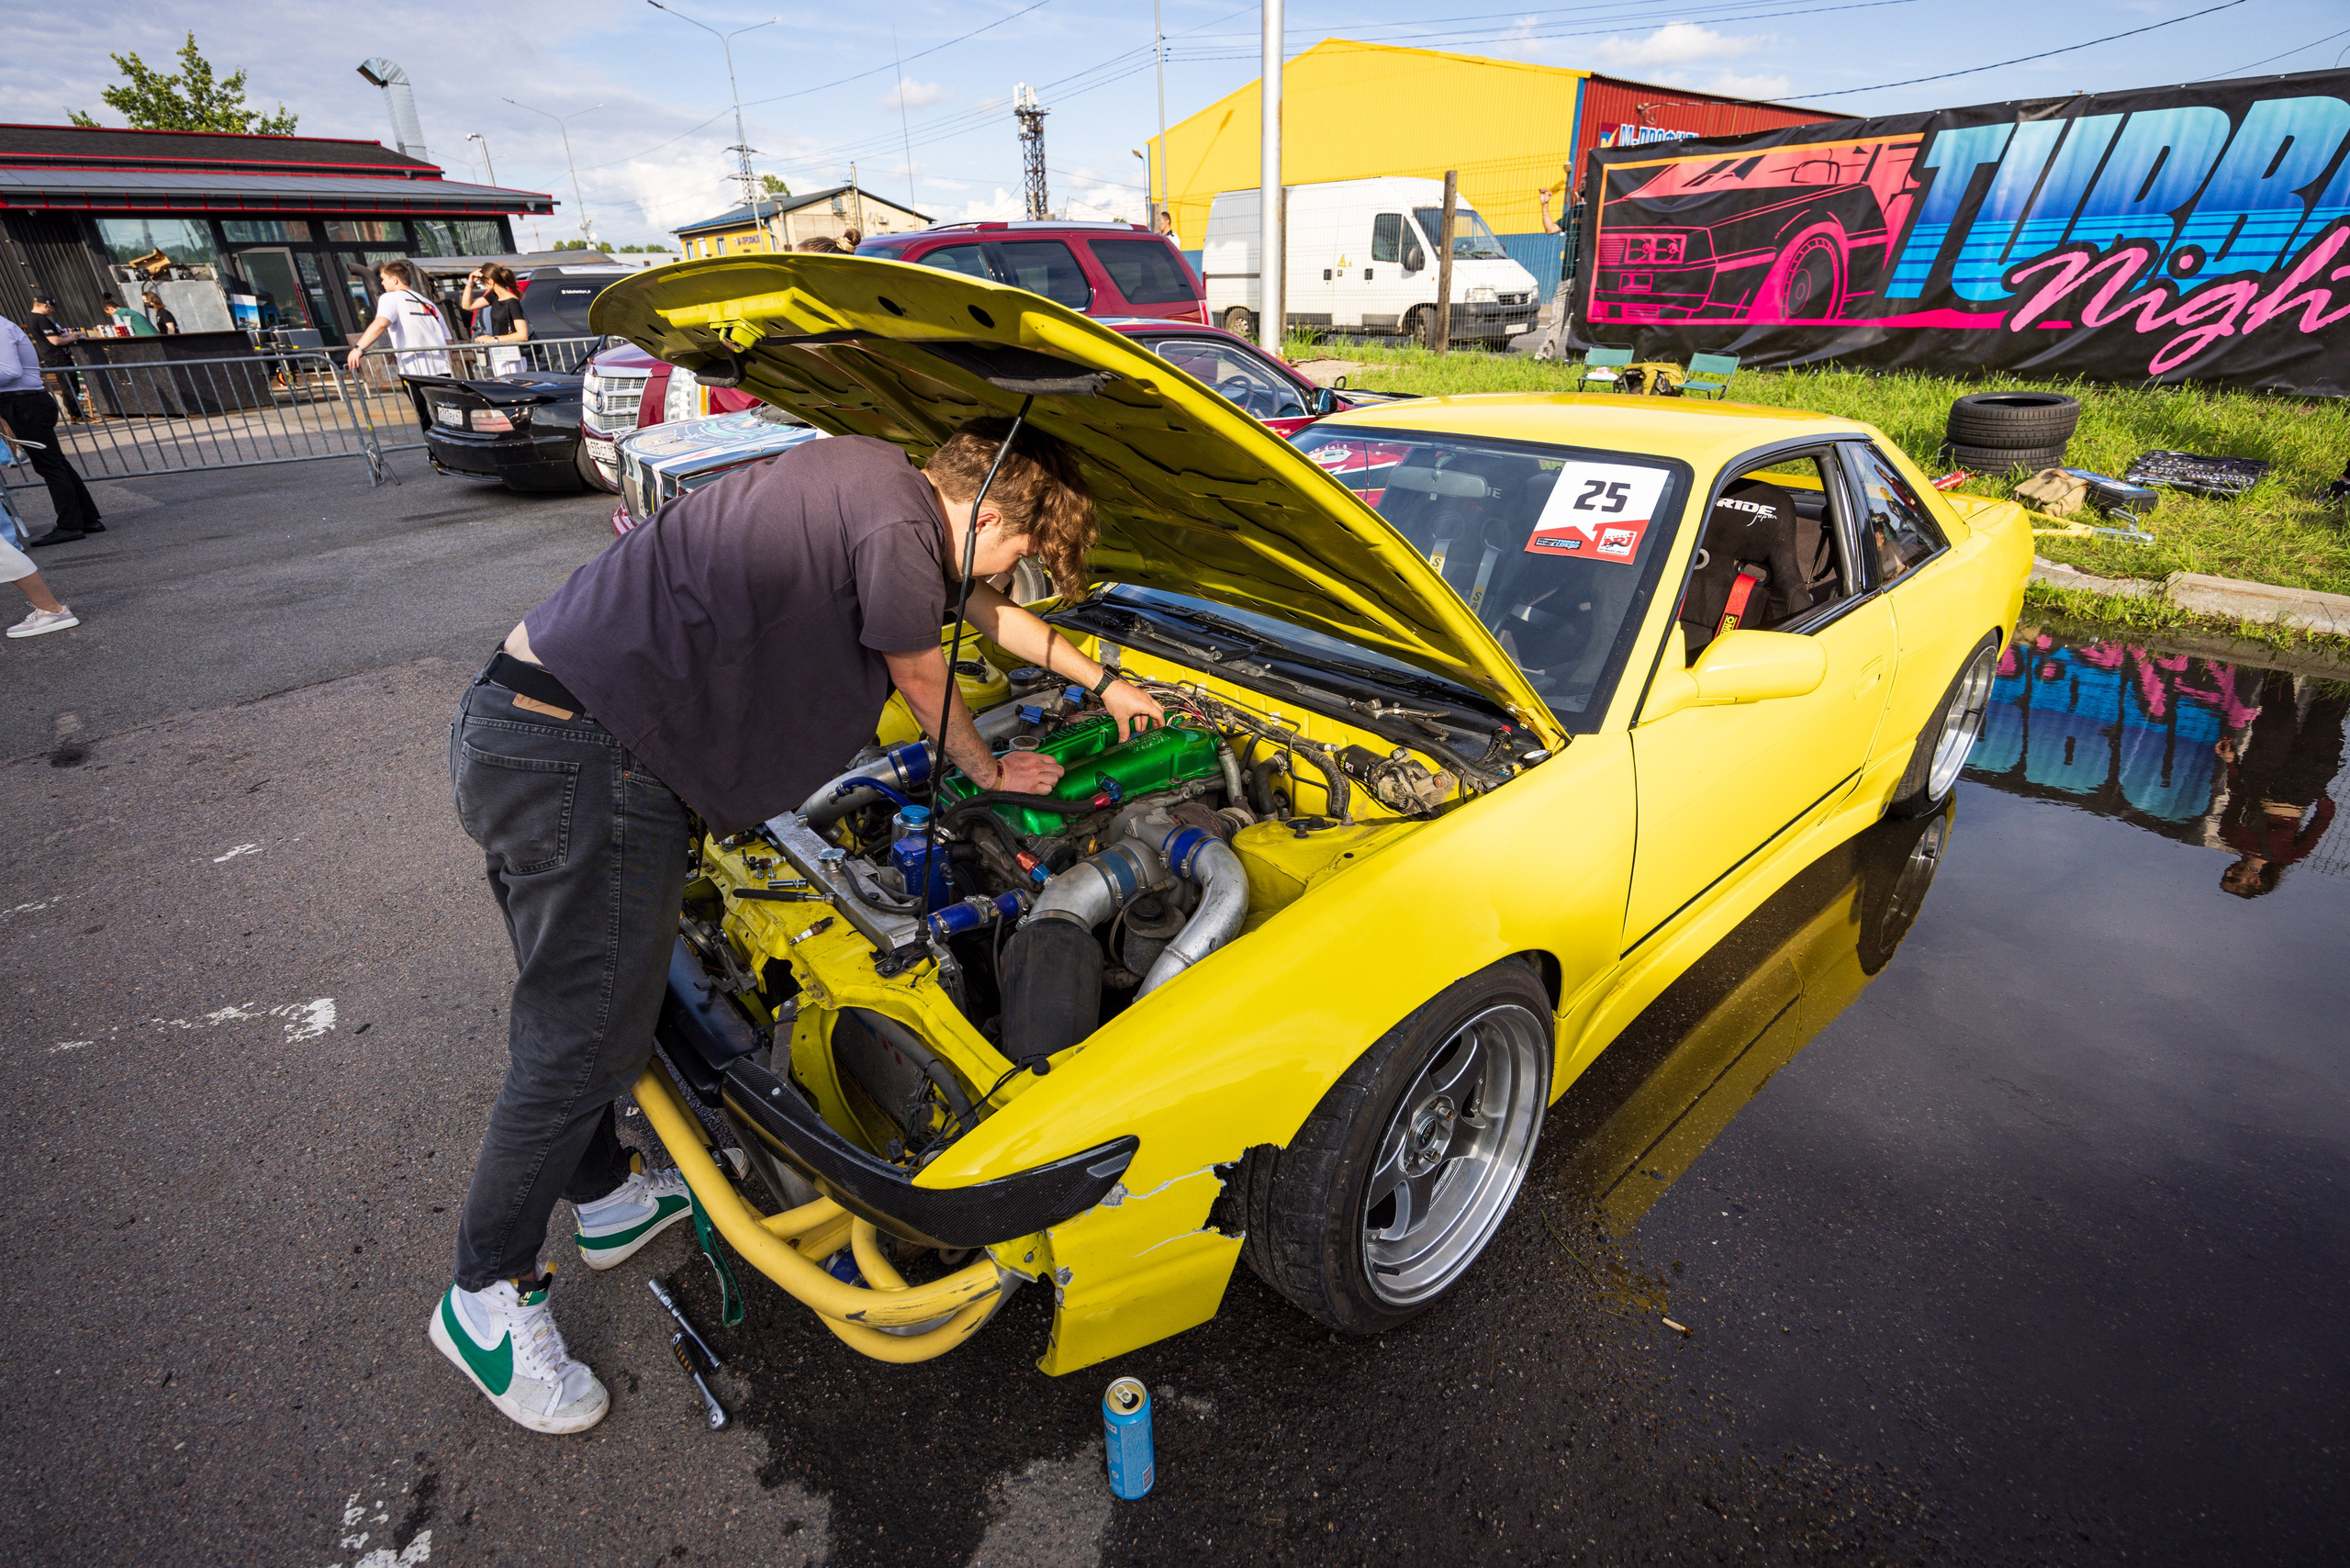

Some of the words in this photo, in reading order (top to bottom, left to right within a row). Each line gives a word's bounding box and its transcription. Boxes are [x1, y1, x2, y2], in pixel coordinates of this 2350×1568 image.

[2009, 226, 2350, 375] Nigh
[1572, 479, 1631, 513] 25
[1716, 498, 1776, 517] RIDE
